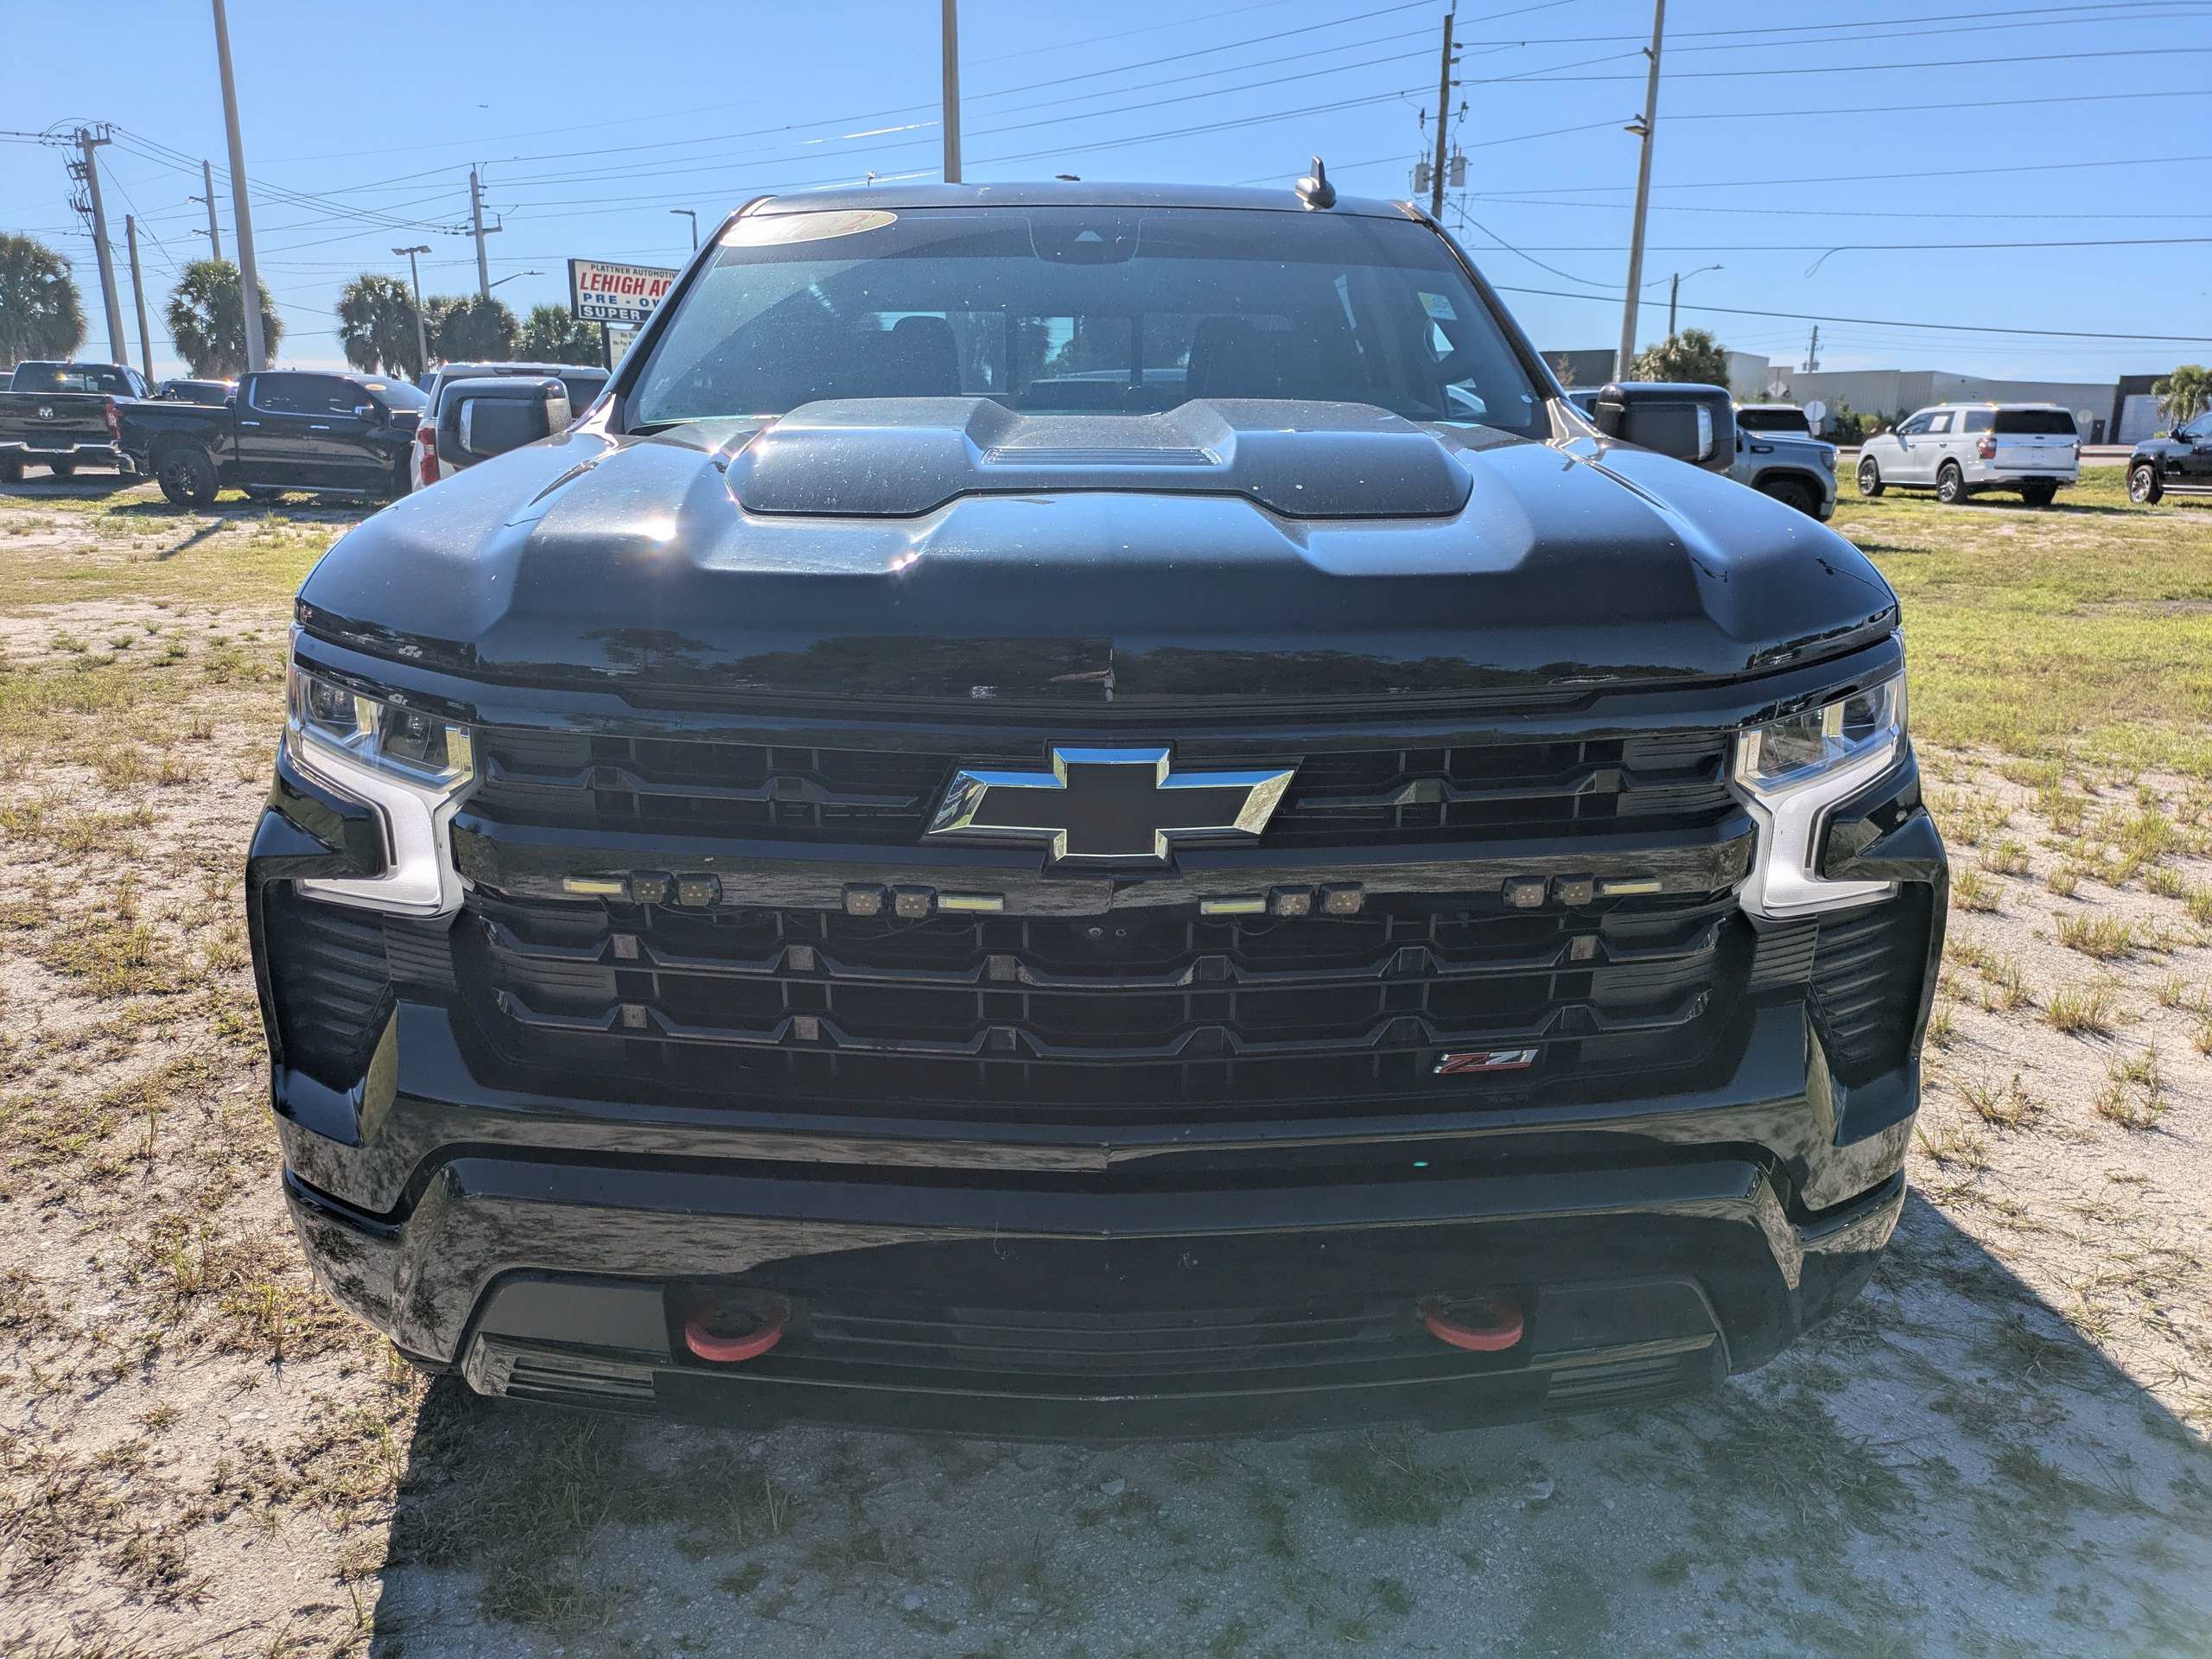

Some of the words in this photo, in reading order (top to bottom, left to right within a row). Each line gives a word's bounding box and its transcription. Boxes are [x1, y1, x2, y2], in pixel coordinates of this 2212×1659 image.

[633, 269, 680, 278] AUTOMOTIV
[580, 272, 646, 295] LEHIGH
[583, 307, 640, 320] SUPER
[1433, 1049, 1539, 1073] Z71
